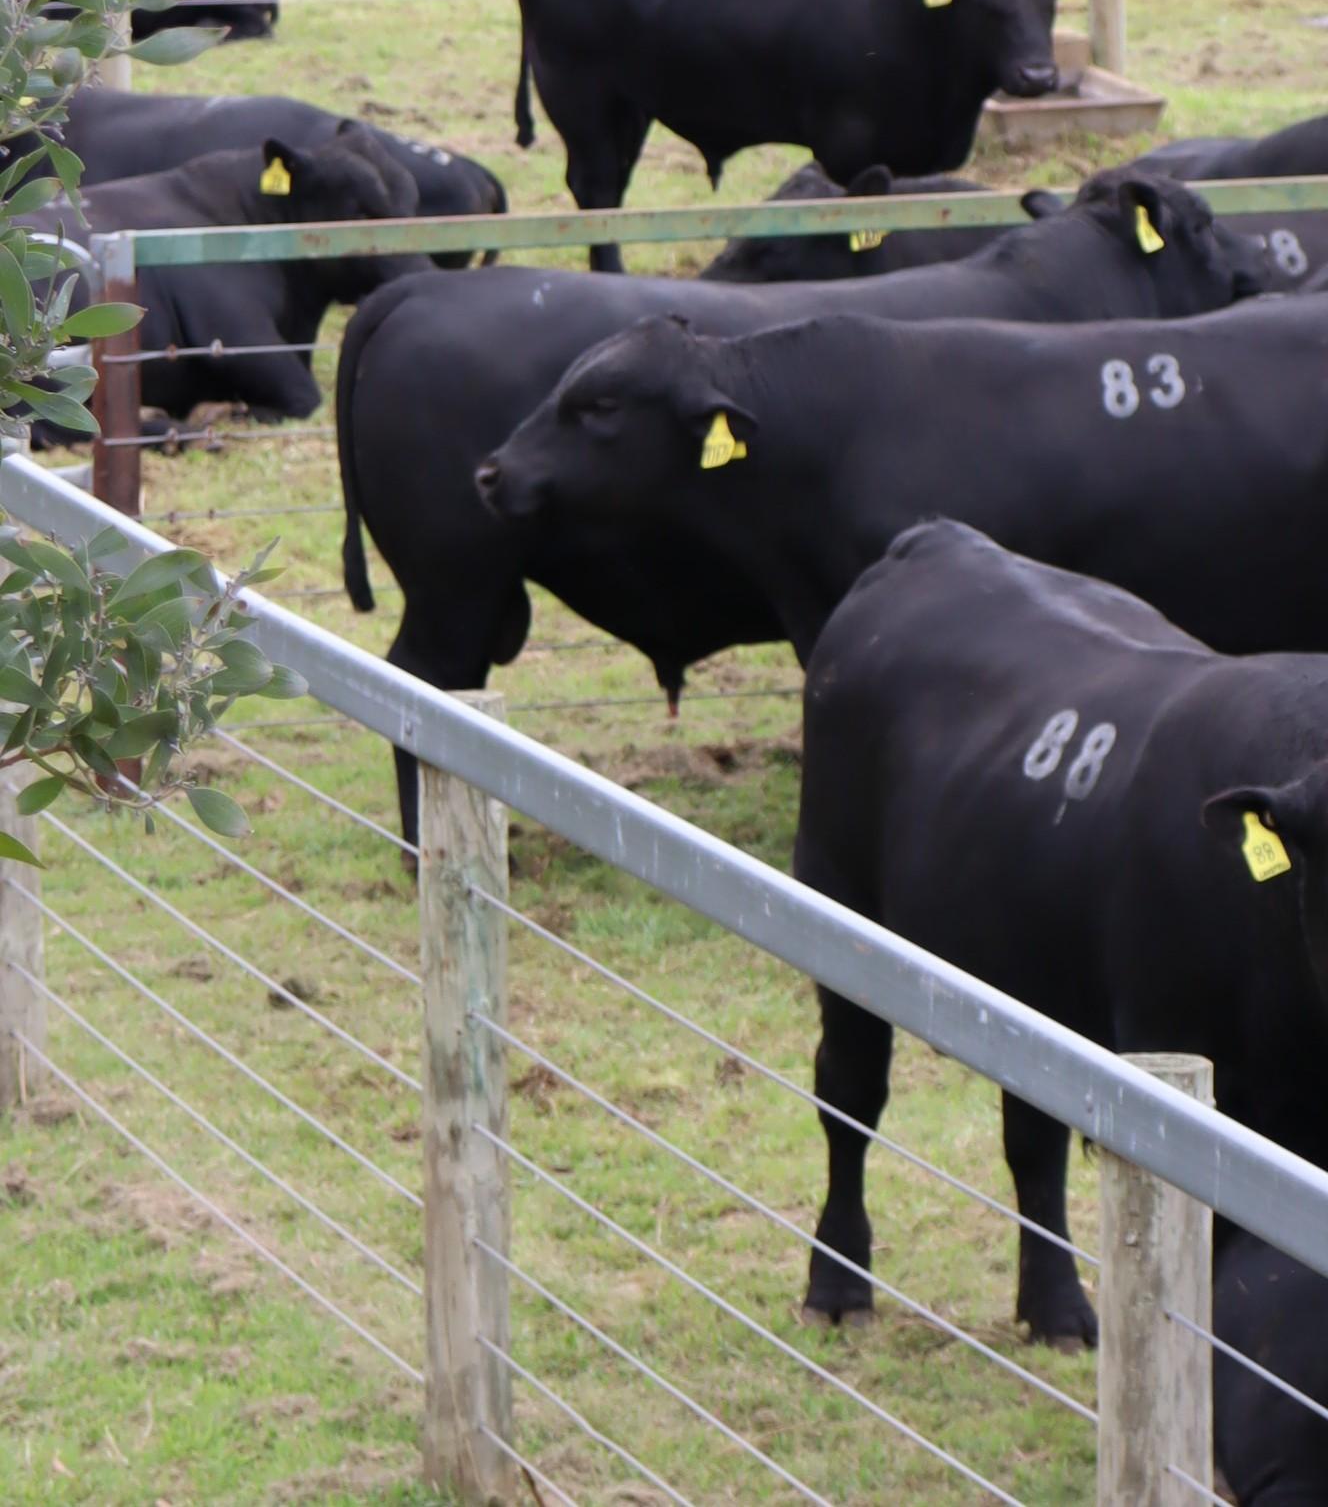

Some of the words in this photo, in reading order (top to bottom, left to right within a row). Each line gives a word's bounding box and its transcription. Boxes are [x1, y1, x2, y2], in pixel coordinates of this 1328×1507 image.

[1101, 353, 1186, 419] 83
[1023, 709, 1117, 802] 88
[1252, 841, 1276, 865] 88
